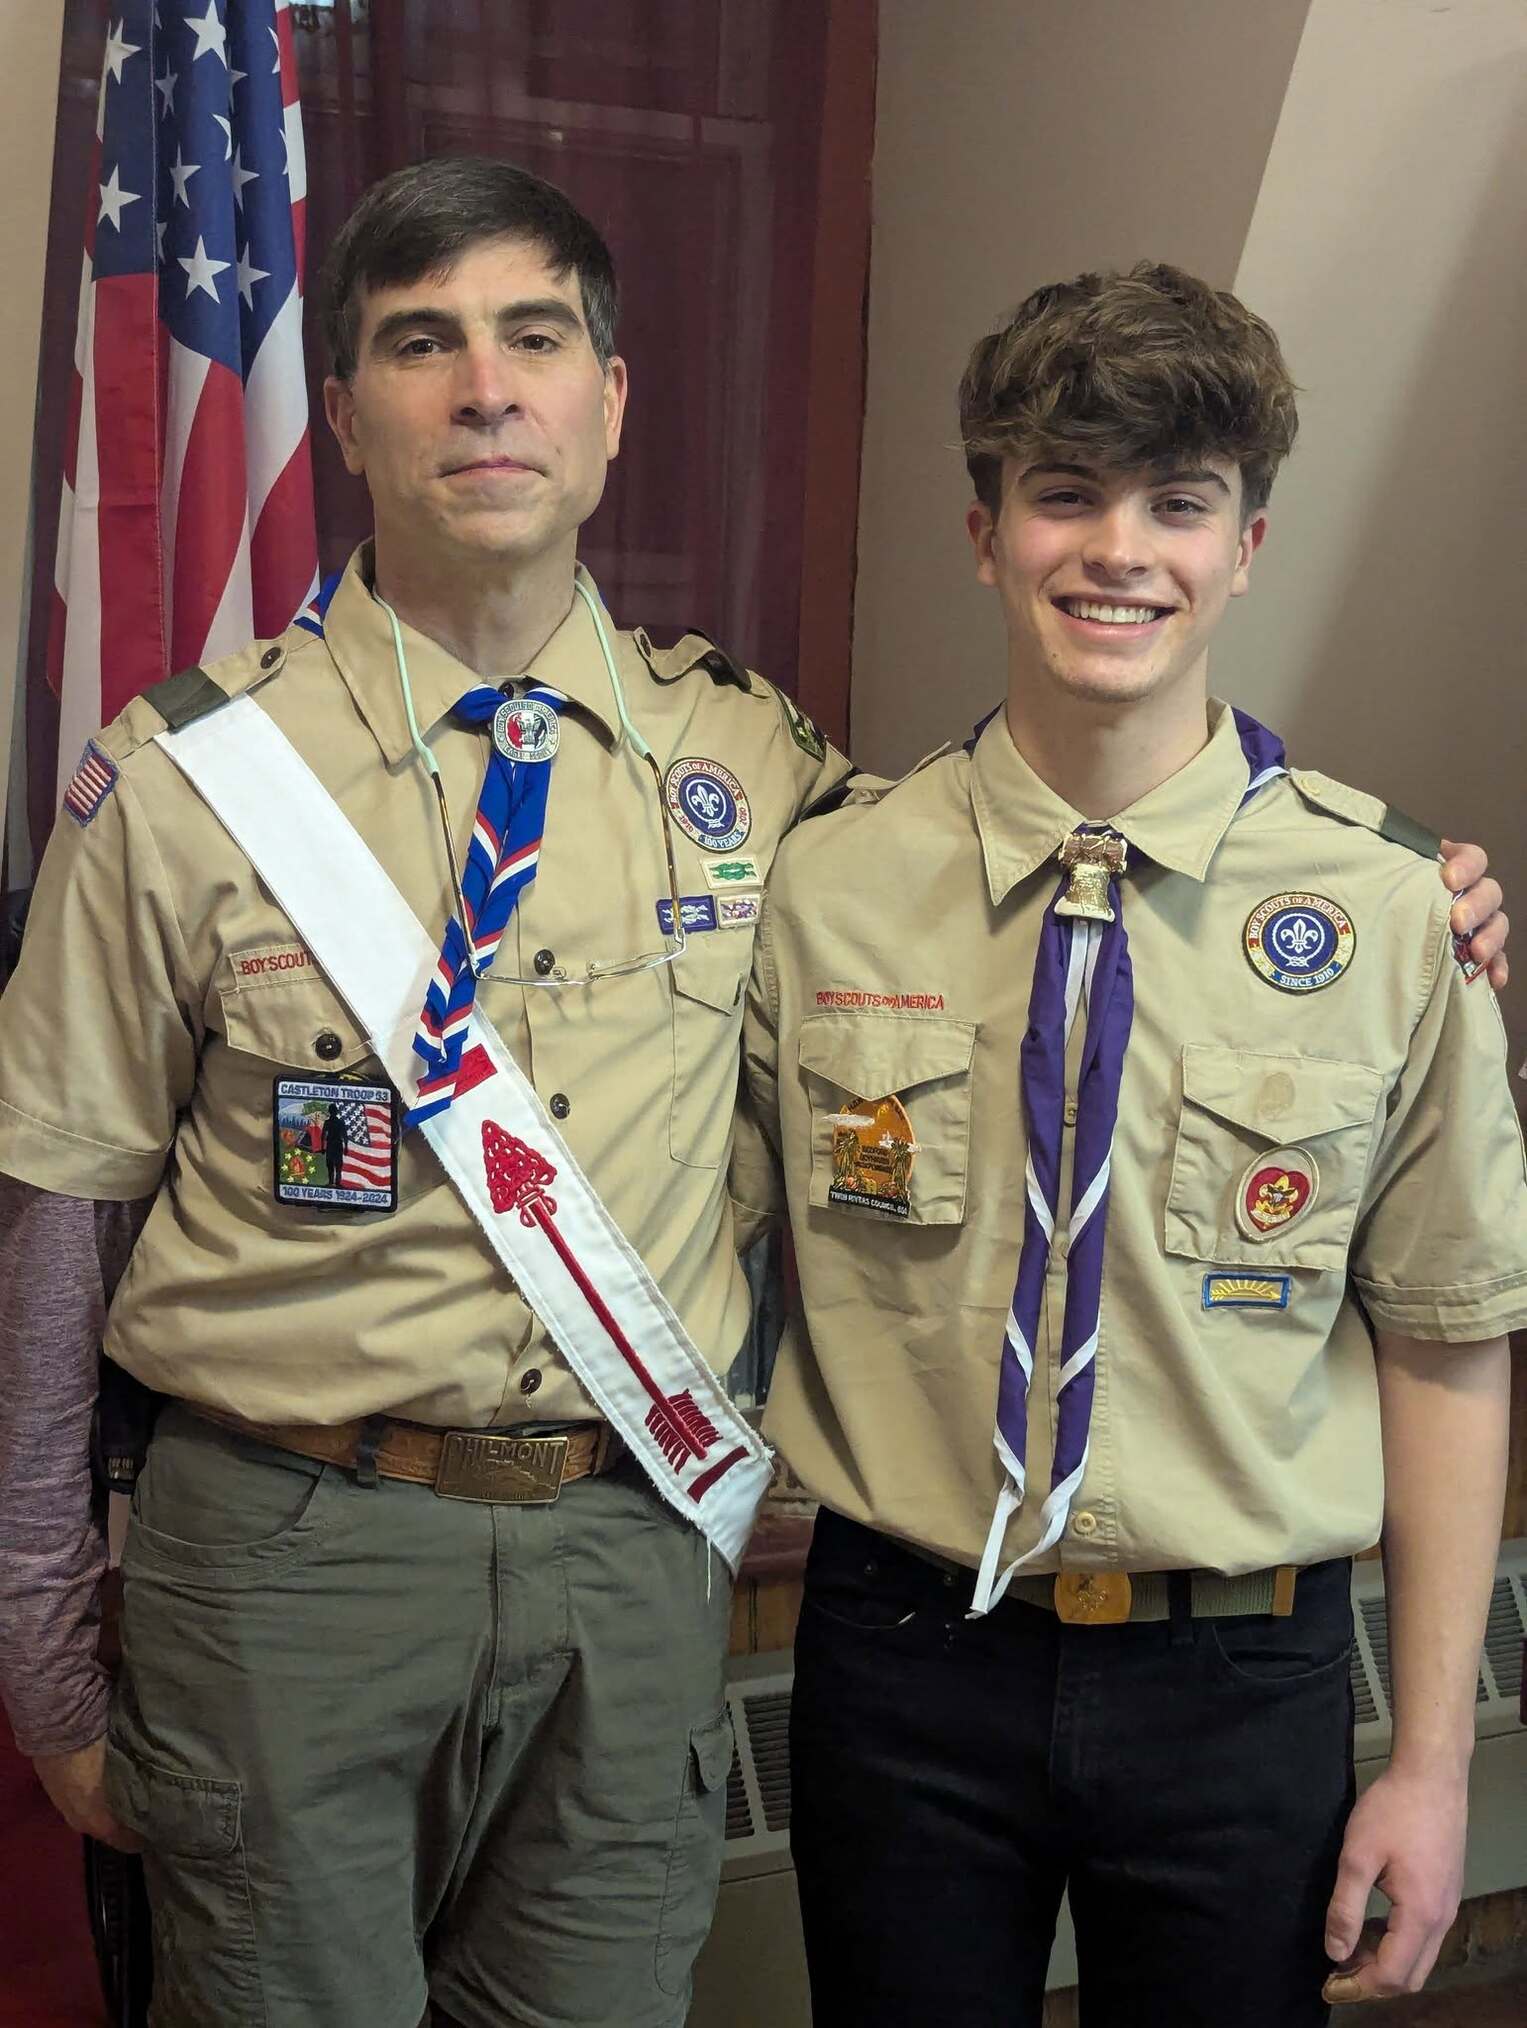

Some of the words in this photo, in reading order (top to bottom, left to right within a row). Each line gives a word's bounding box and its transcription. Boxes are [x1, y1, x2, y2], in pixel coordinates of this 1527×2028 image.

[1249, 918, 1260, 938] BOY
[1256, 897, 1291, 920] SCOUTS
[1303, 896, 1346, 928] AMERICA
[241, 957, 267, 975] BOY
[1280, 975, 1313, 987] SINCE
[1313, 968, 1335, 982] 1910
[835, 991, 881, 1008] SCOUTS
[892, 994, 944, 1010] AMERICA
[281, 1084, 339, 1098] CASTLETON
[341, 1088, 374, 1100] TROOP
[282, 1186, 300, 1197] 100
[301, 1187, 333, 1200] YEARS
